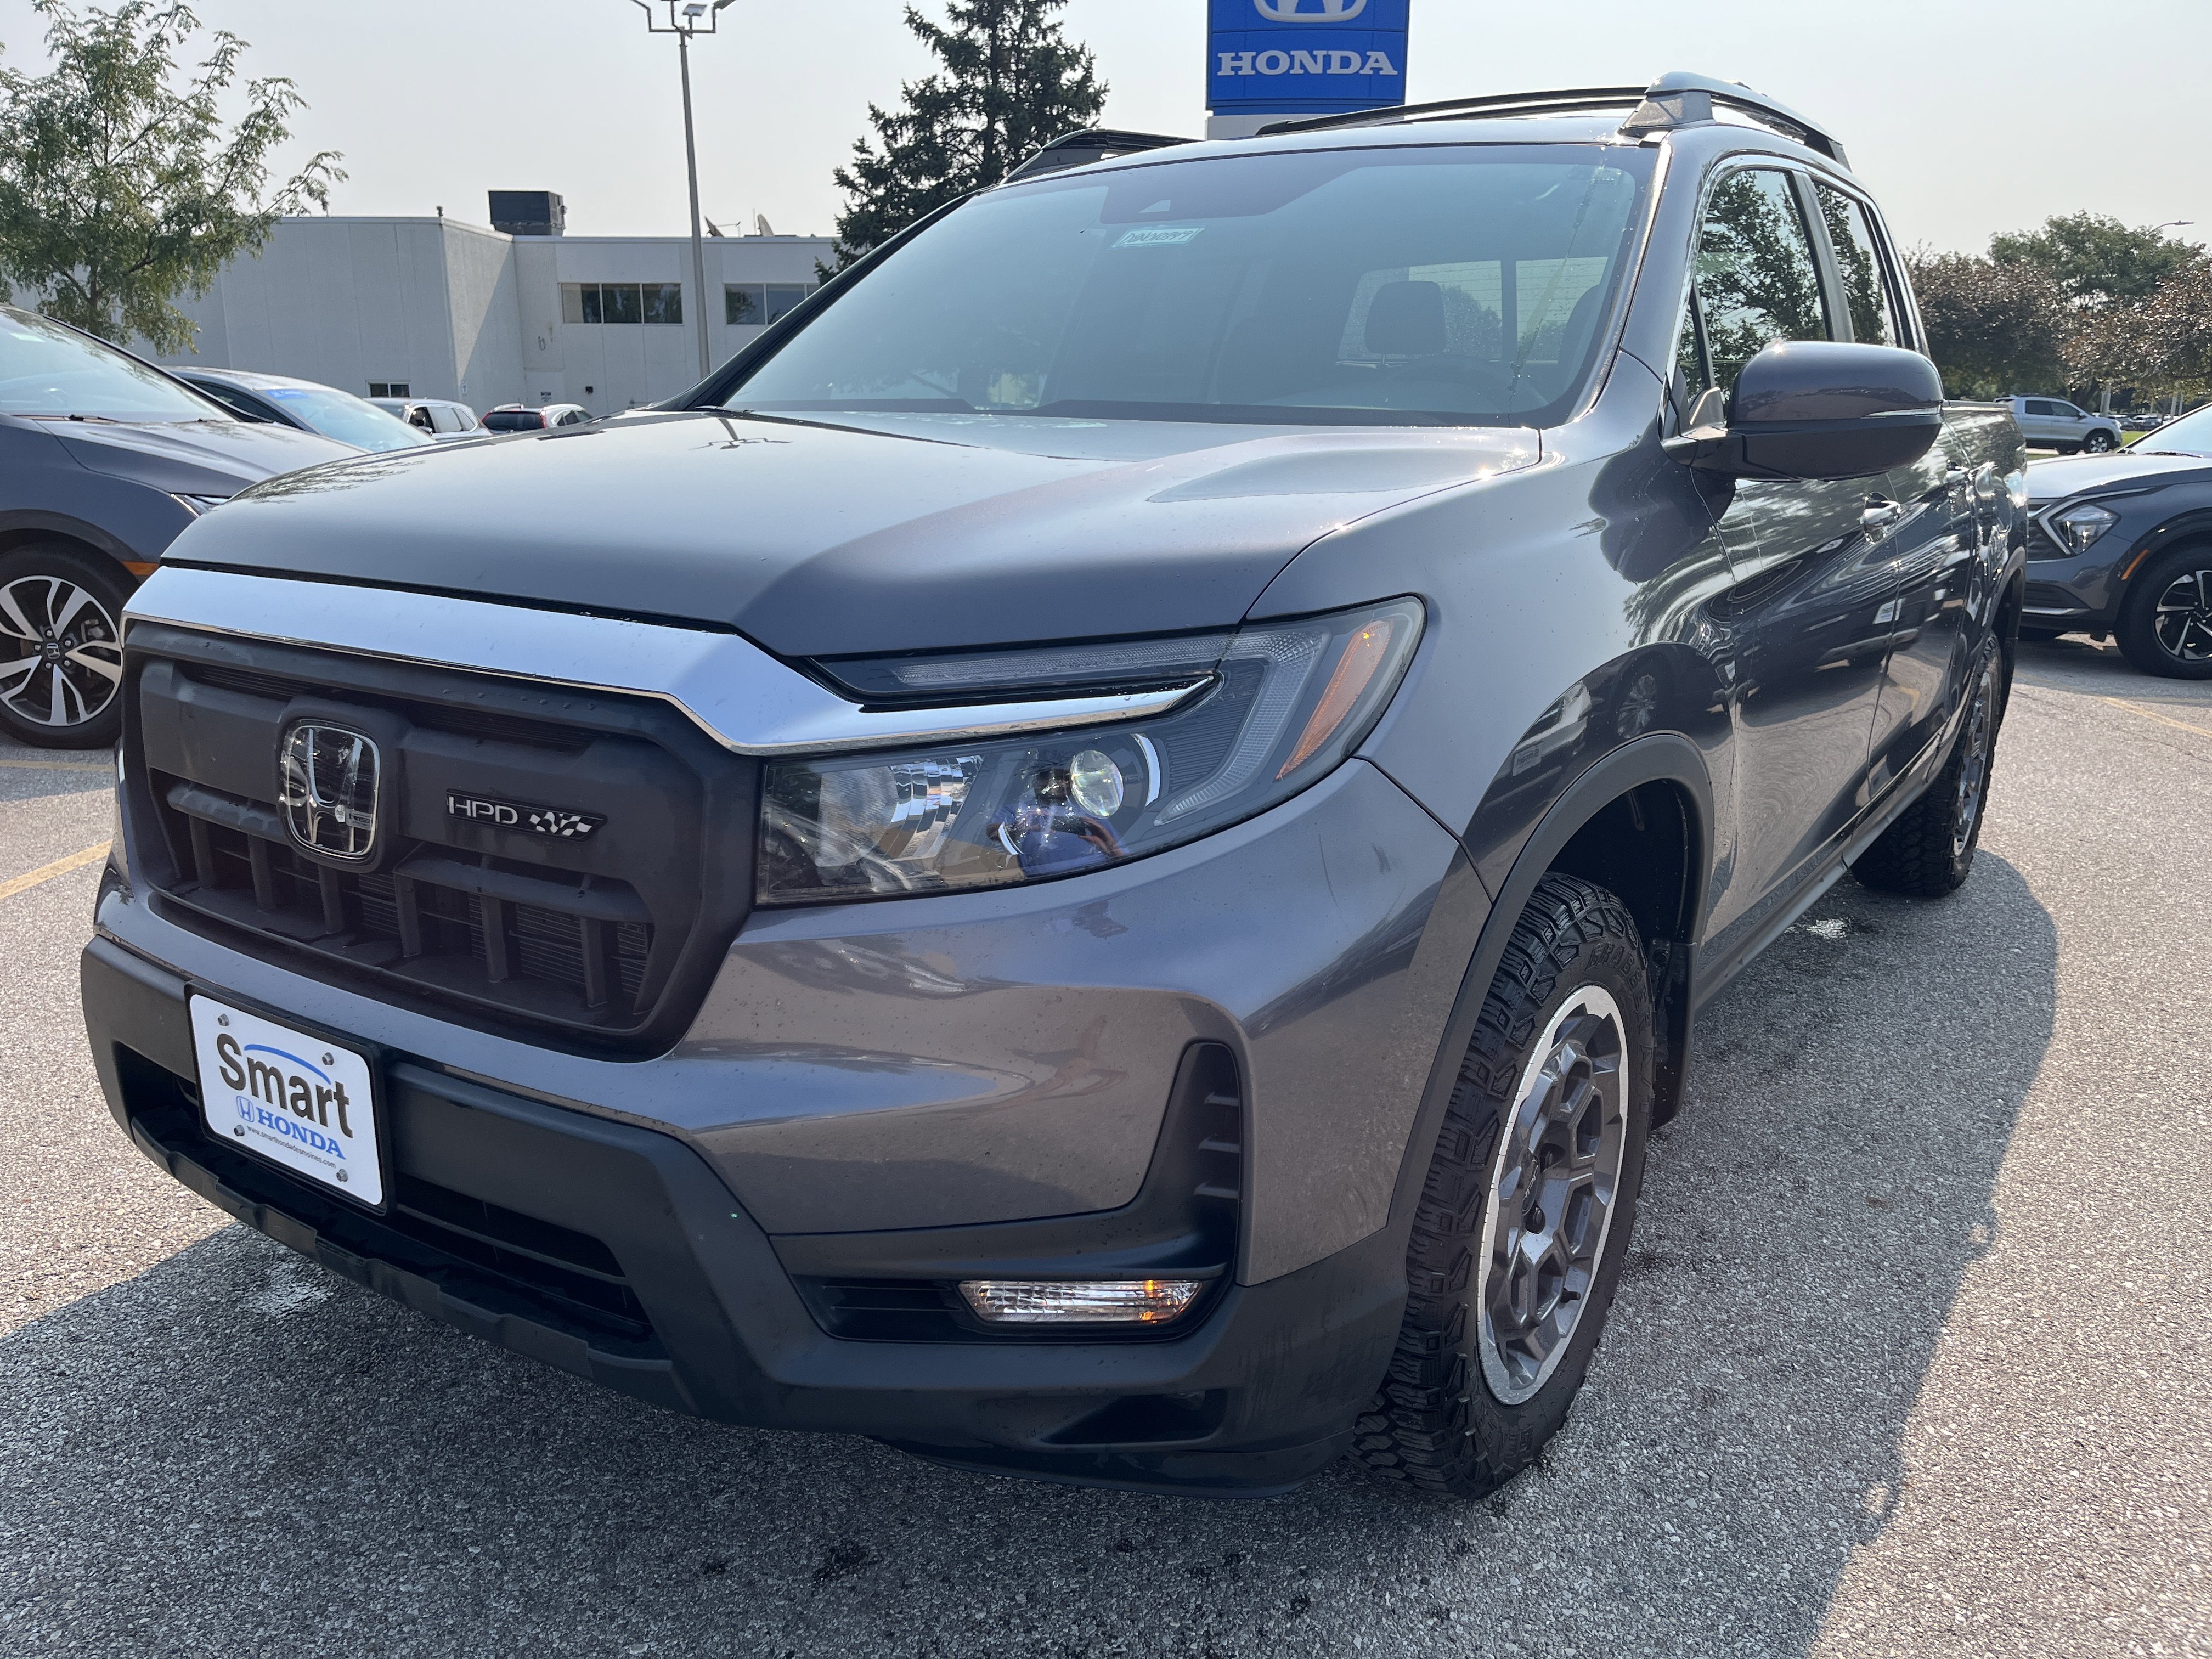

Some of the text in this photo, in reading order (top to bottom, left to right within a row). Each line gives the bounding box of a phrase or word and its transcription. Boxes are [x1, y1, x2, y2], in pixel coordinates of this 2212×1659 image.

[1217, 50, 1398, 76] HONDA
[448, 796, 518, 825] HPD
[217, 1033, 354, 1139] Smart
[256, 1107, 347, 1160] HONDA
